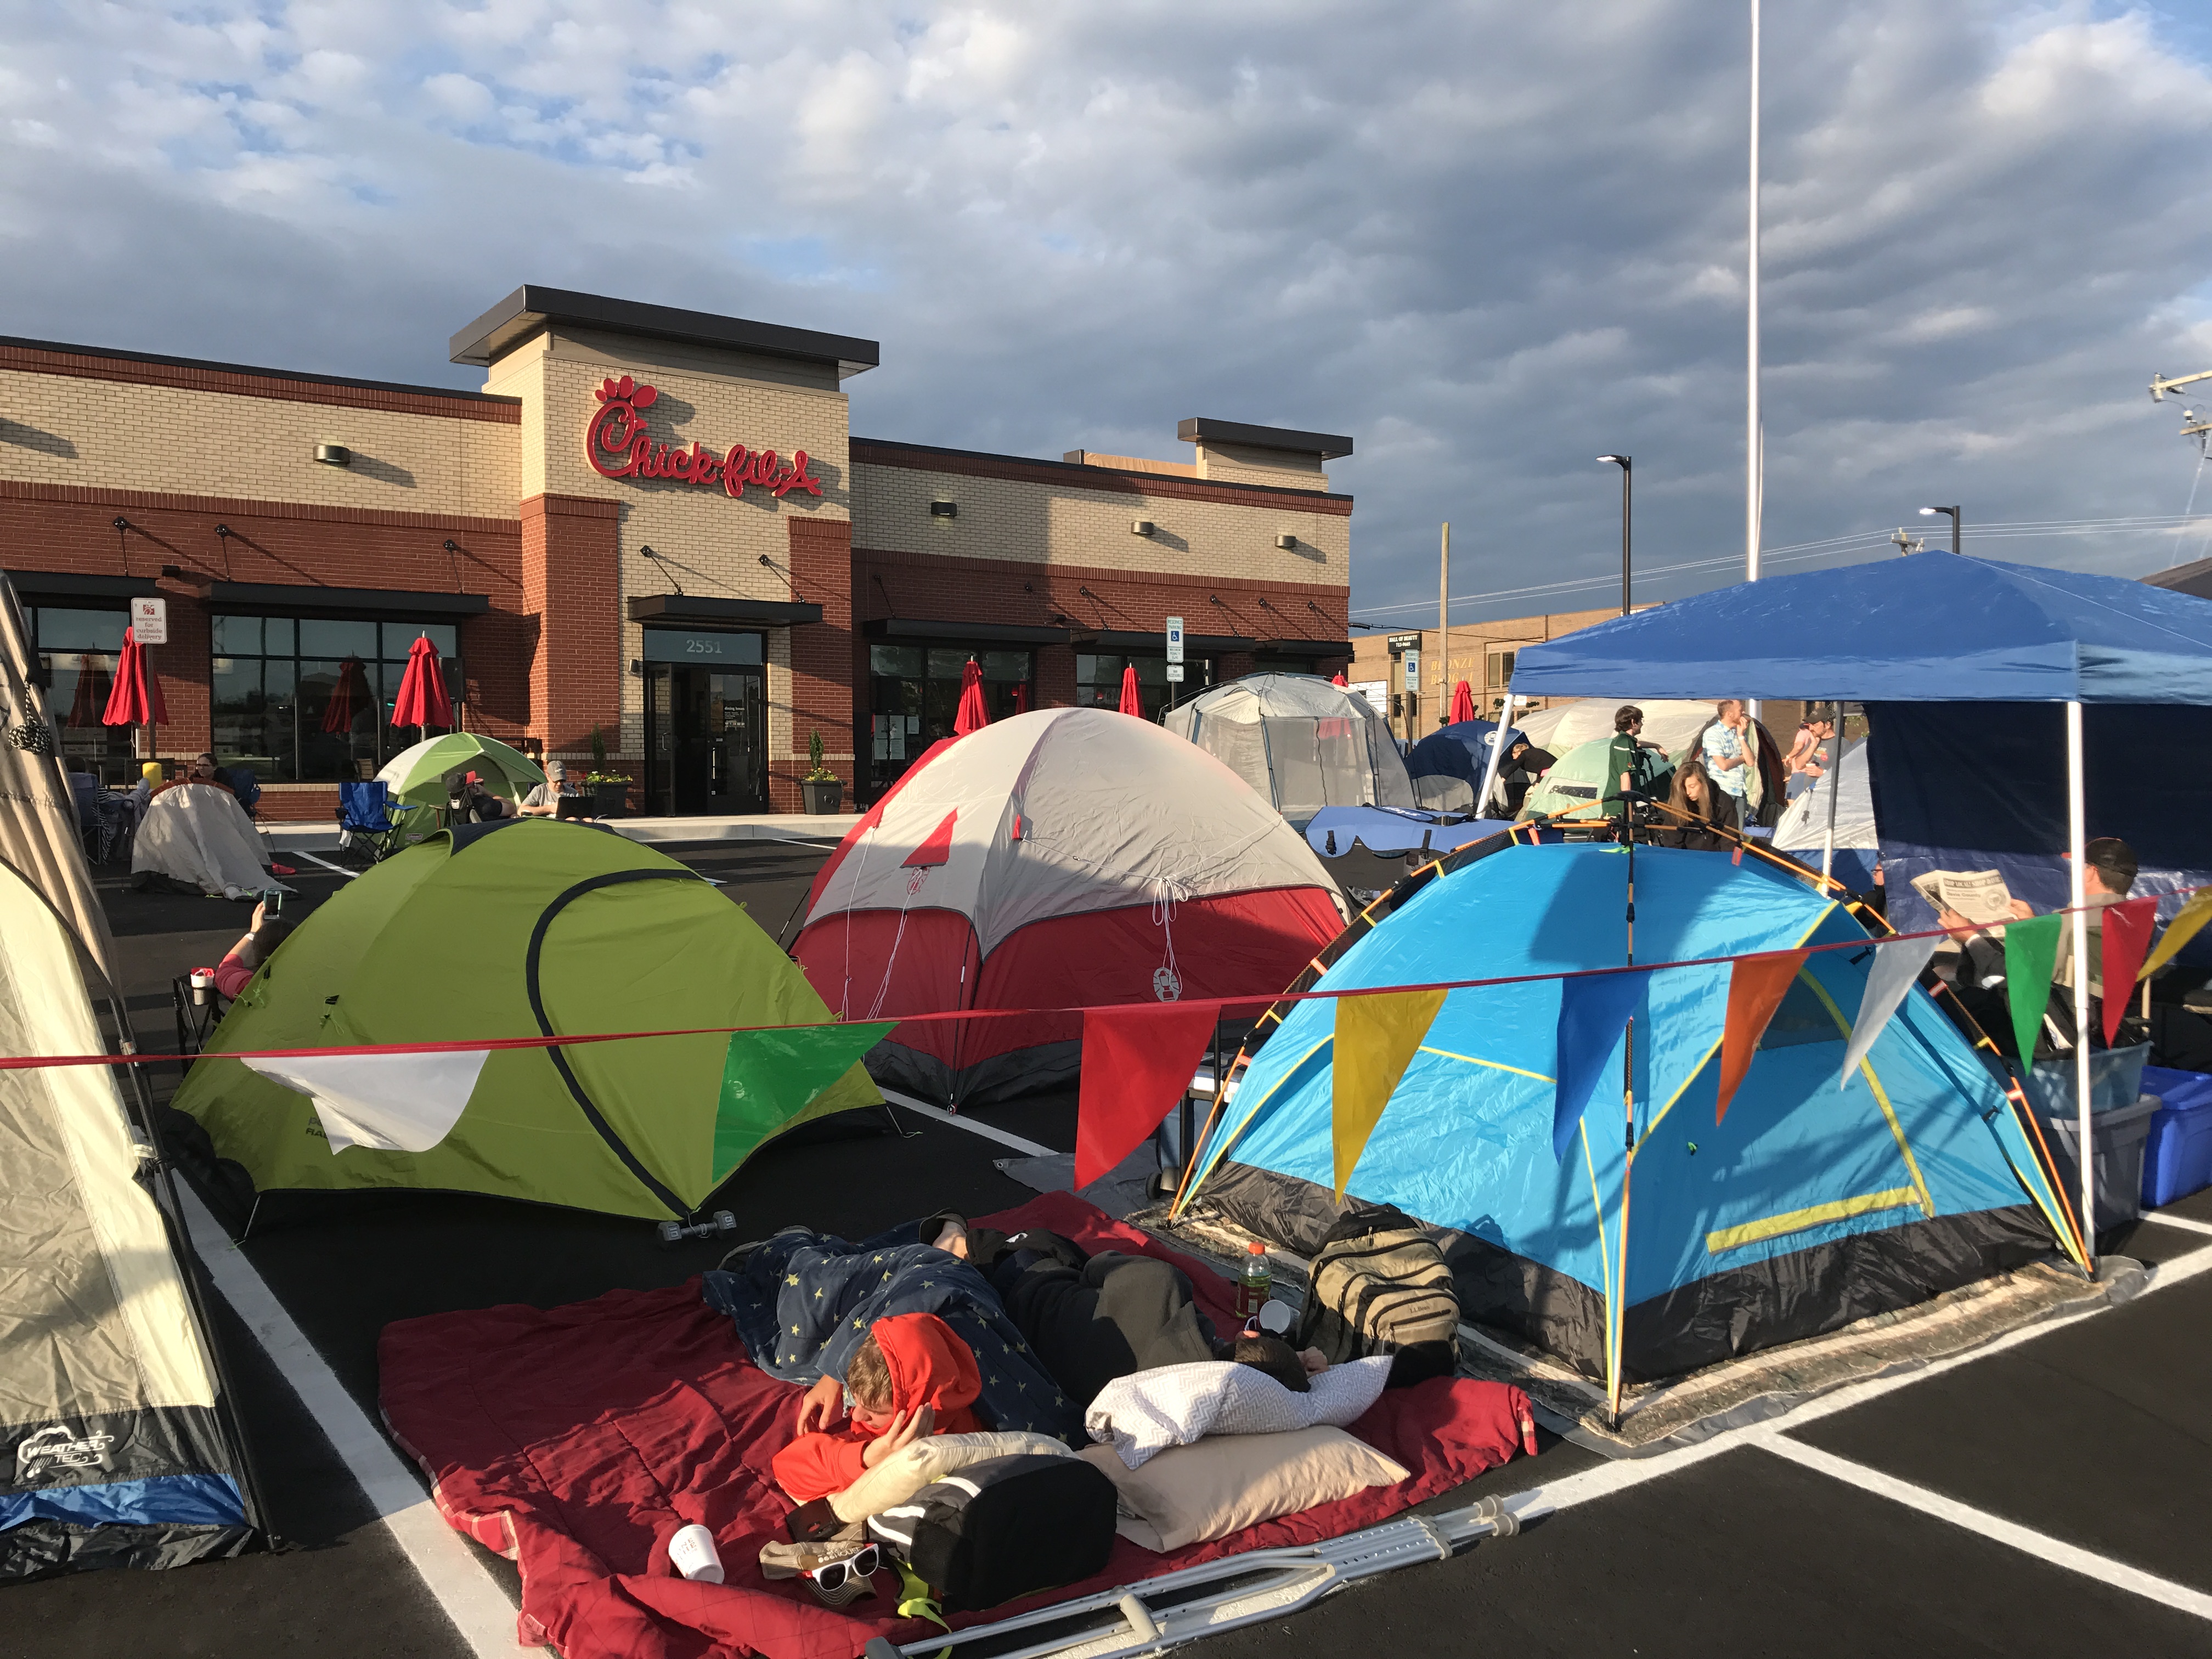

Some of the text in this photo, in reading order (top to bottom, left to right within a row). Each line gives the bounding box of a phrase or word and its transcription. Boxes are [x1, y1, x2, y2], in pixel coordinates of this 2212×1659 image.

[584, 375, 823, 498] Chick-fil-A
[686, 639, 723, 653] 2551
[1431, 657, 1475, 671] BONZE
[27, 1440, 99, 1458] WEATHER
[54, 1453, 82, 1463] TEC
